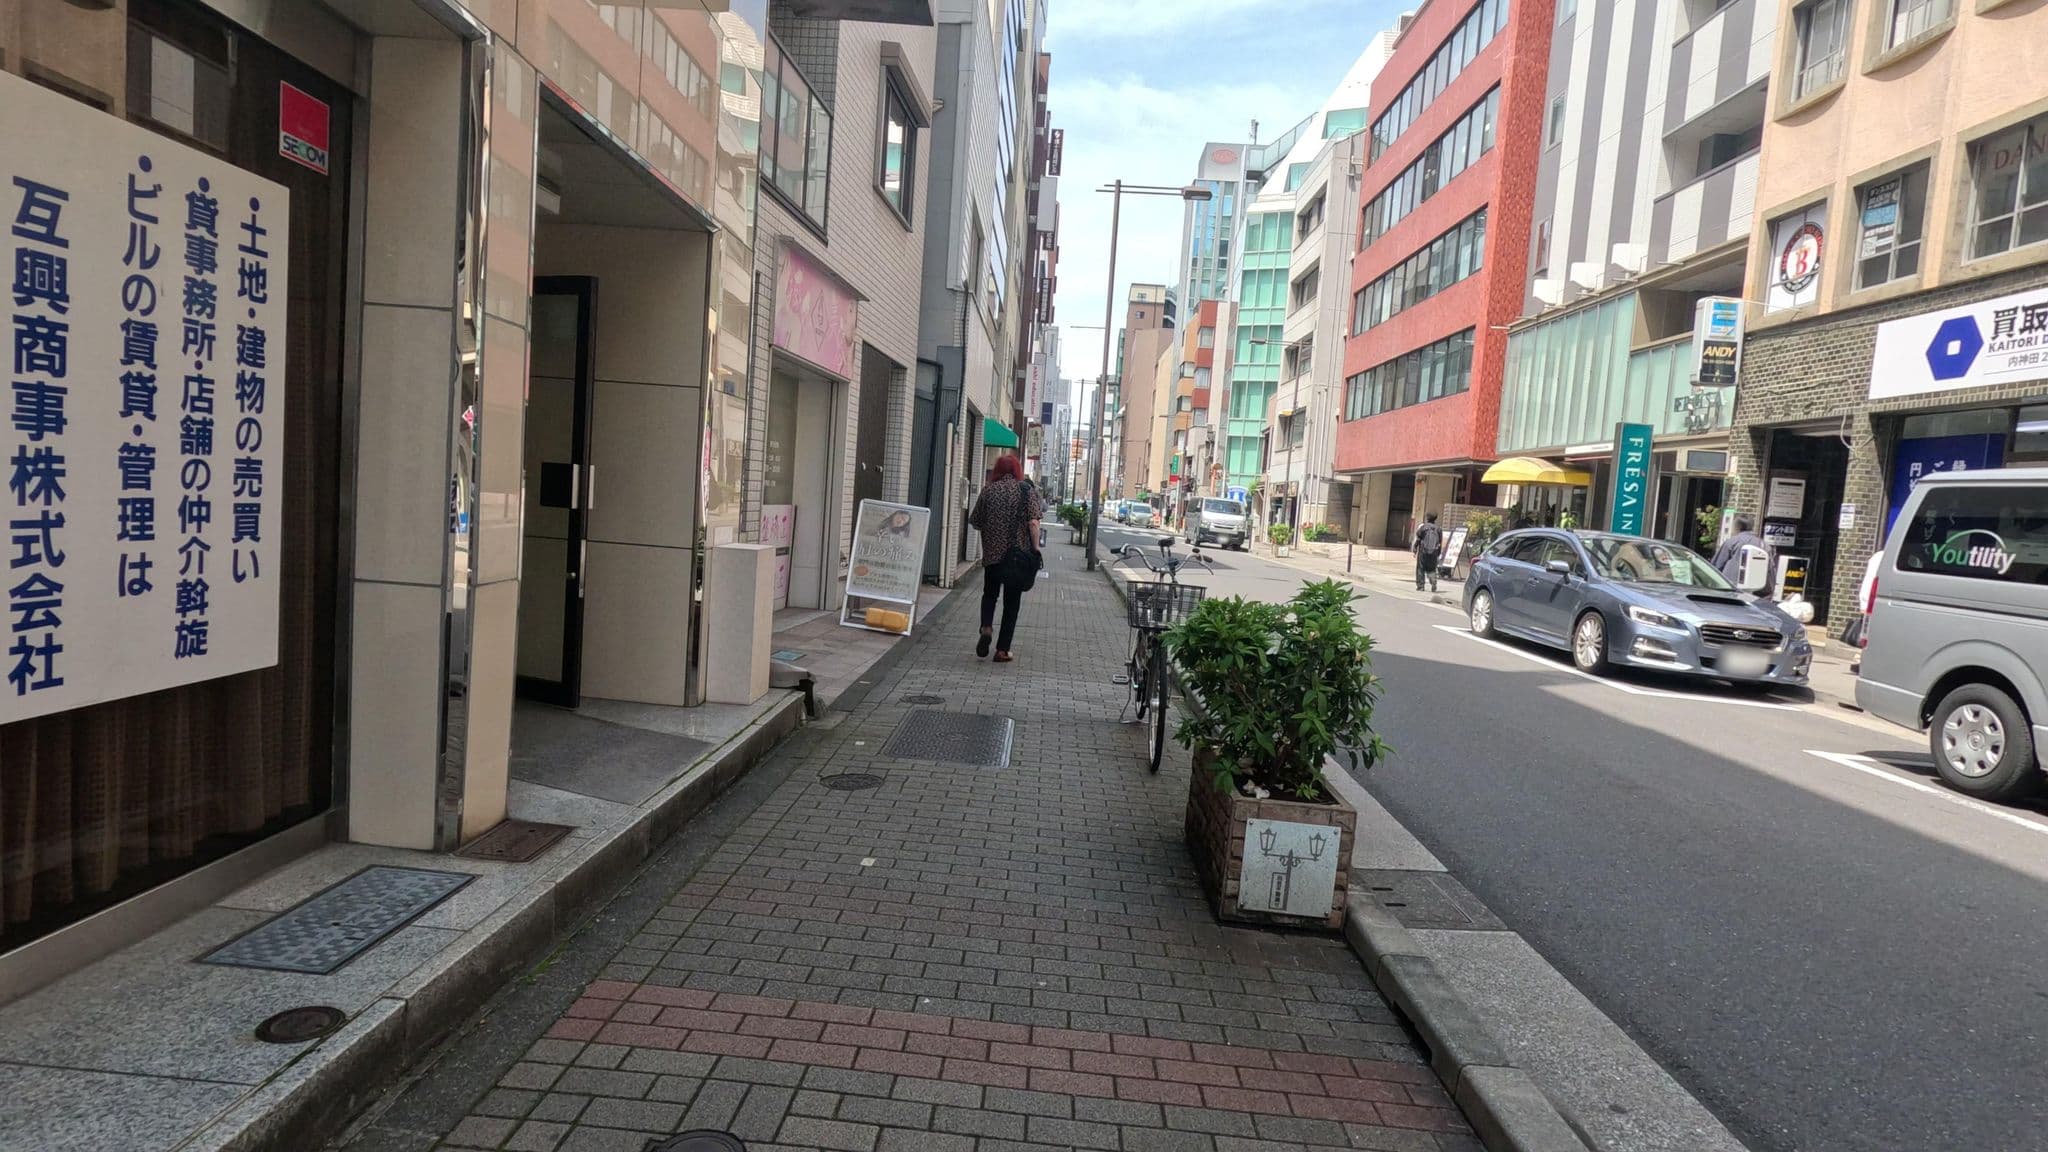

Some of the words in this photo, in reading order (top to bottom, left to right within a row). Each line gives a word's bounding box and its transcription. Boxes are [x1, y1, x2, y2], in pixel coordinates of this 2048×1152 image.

[283, 135, 327, 168] SECOM
[1991, 302, 2048, 340] 買取
[1703, 345, 1737, 358] ANDY
[1988, 337, 2038, 353] KAITORI
[2008, 352, 2039, 368] 内神田
[8, 175, 70, 697] 互興商事株式会社
[1932, 543, 2017, 574] Youtility
